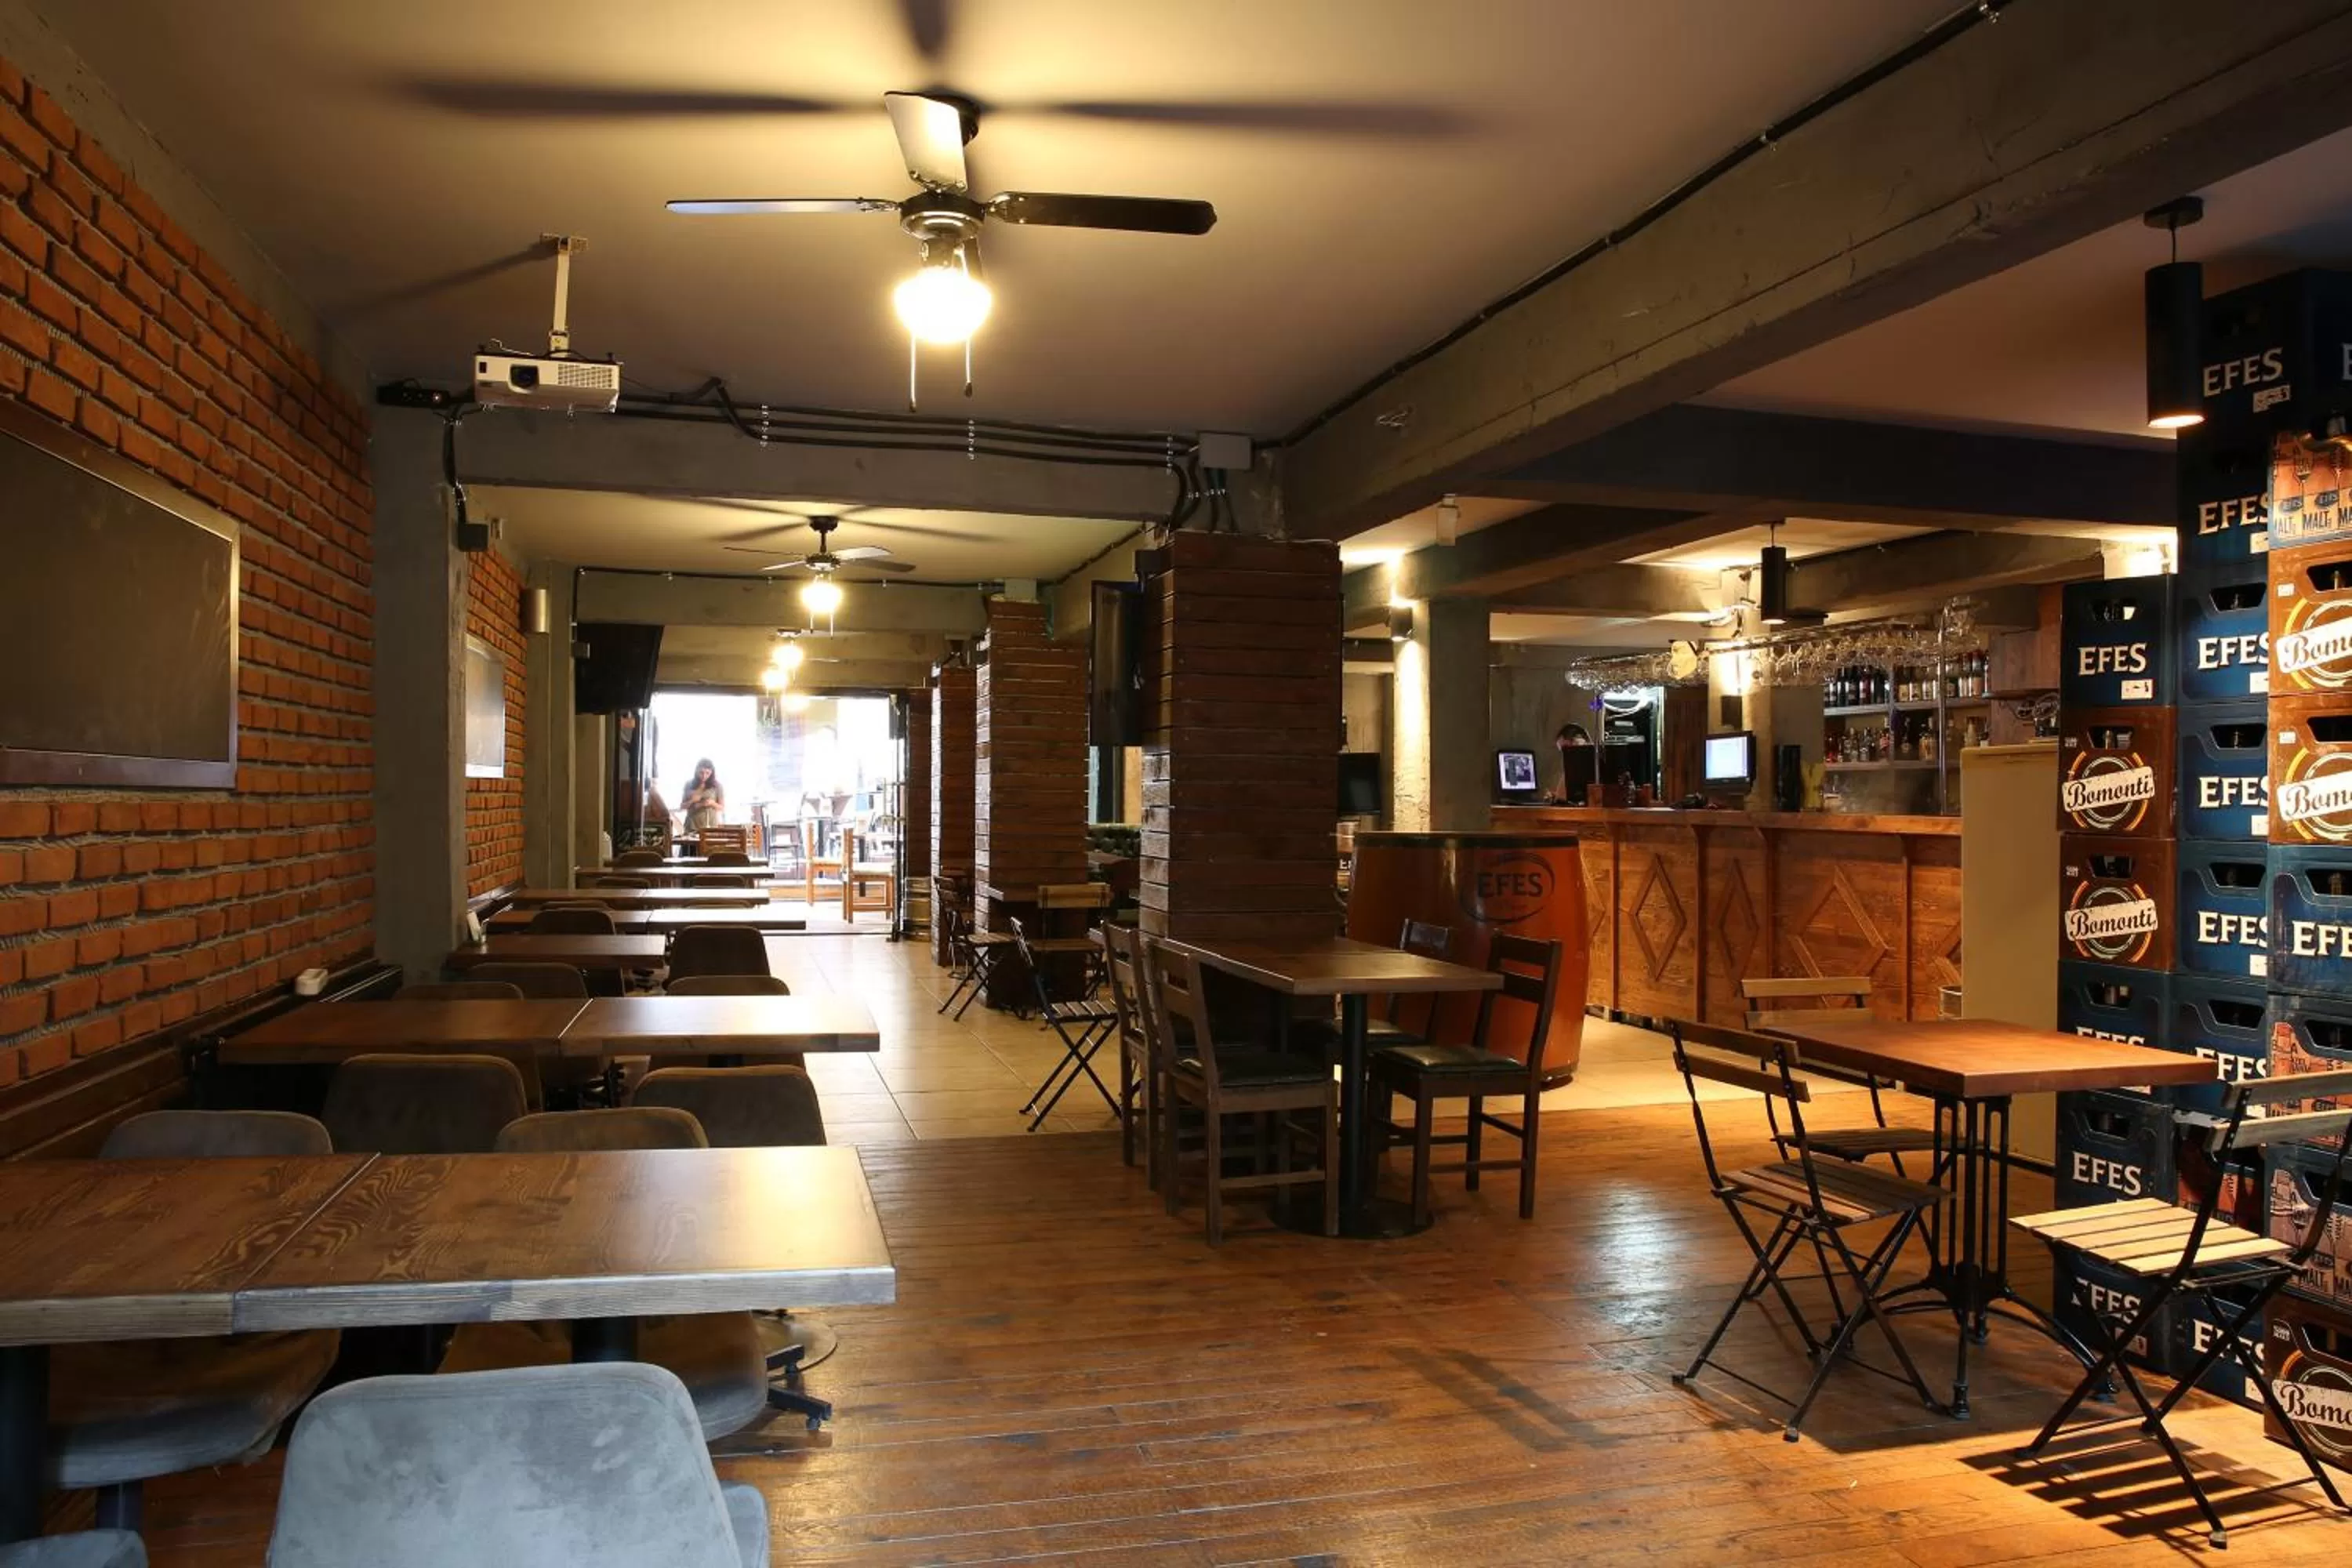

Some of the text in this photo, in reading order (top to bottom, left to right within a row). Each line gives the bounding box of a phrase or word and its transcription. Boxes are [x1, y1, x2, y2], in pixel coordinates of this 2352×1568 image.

[2203, 347, 2283, 397] EFES
[2303, 510, 2328, 530] MALT
[2078, 643, 2147, 676] EFES
[2067, 774, 2154, 808] Bomonti
[1477, 871, 1544, 897] EFES
[2070, 907, 2156, 937] Bomonti
[2072, 1150, 2142, 1196] EFES
